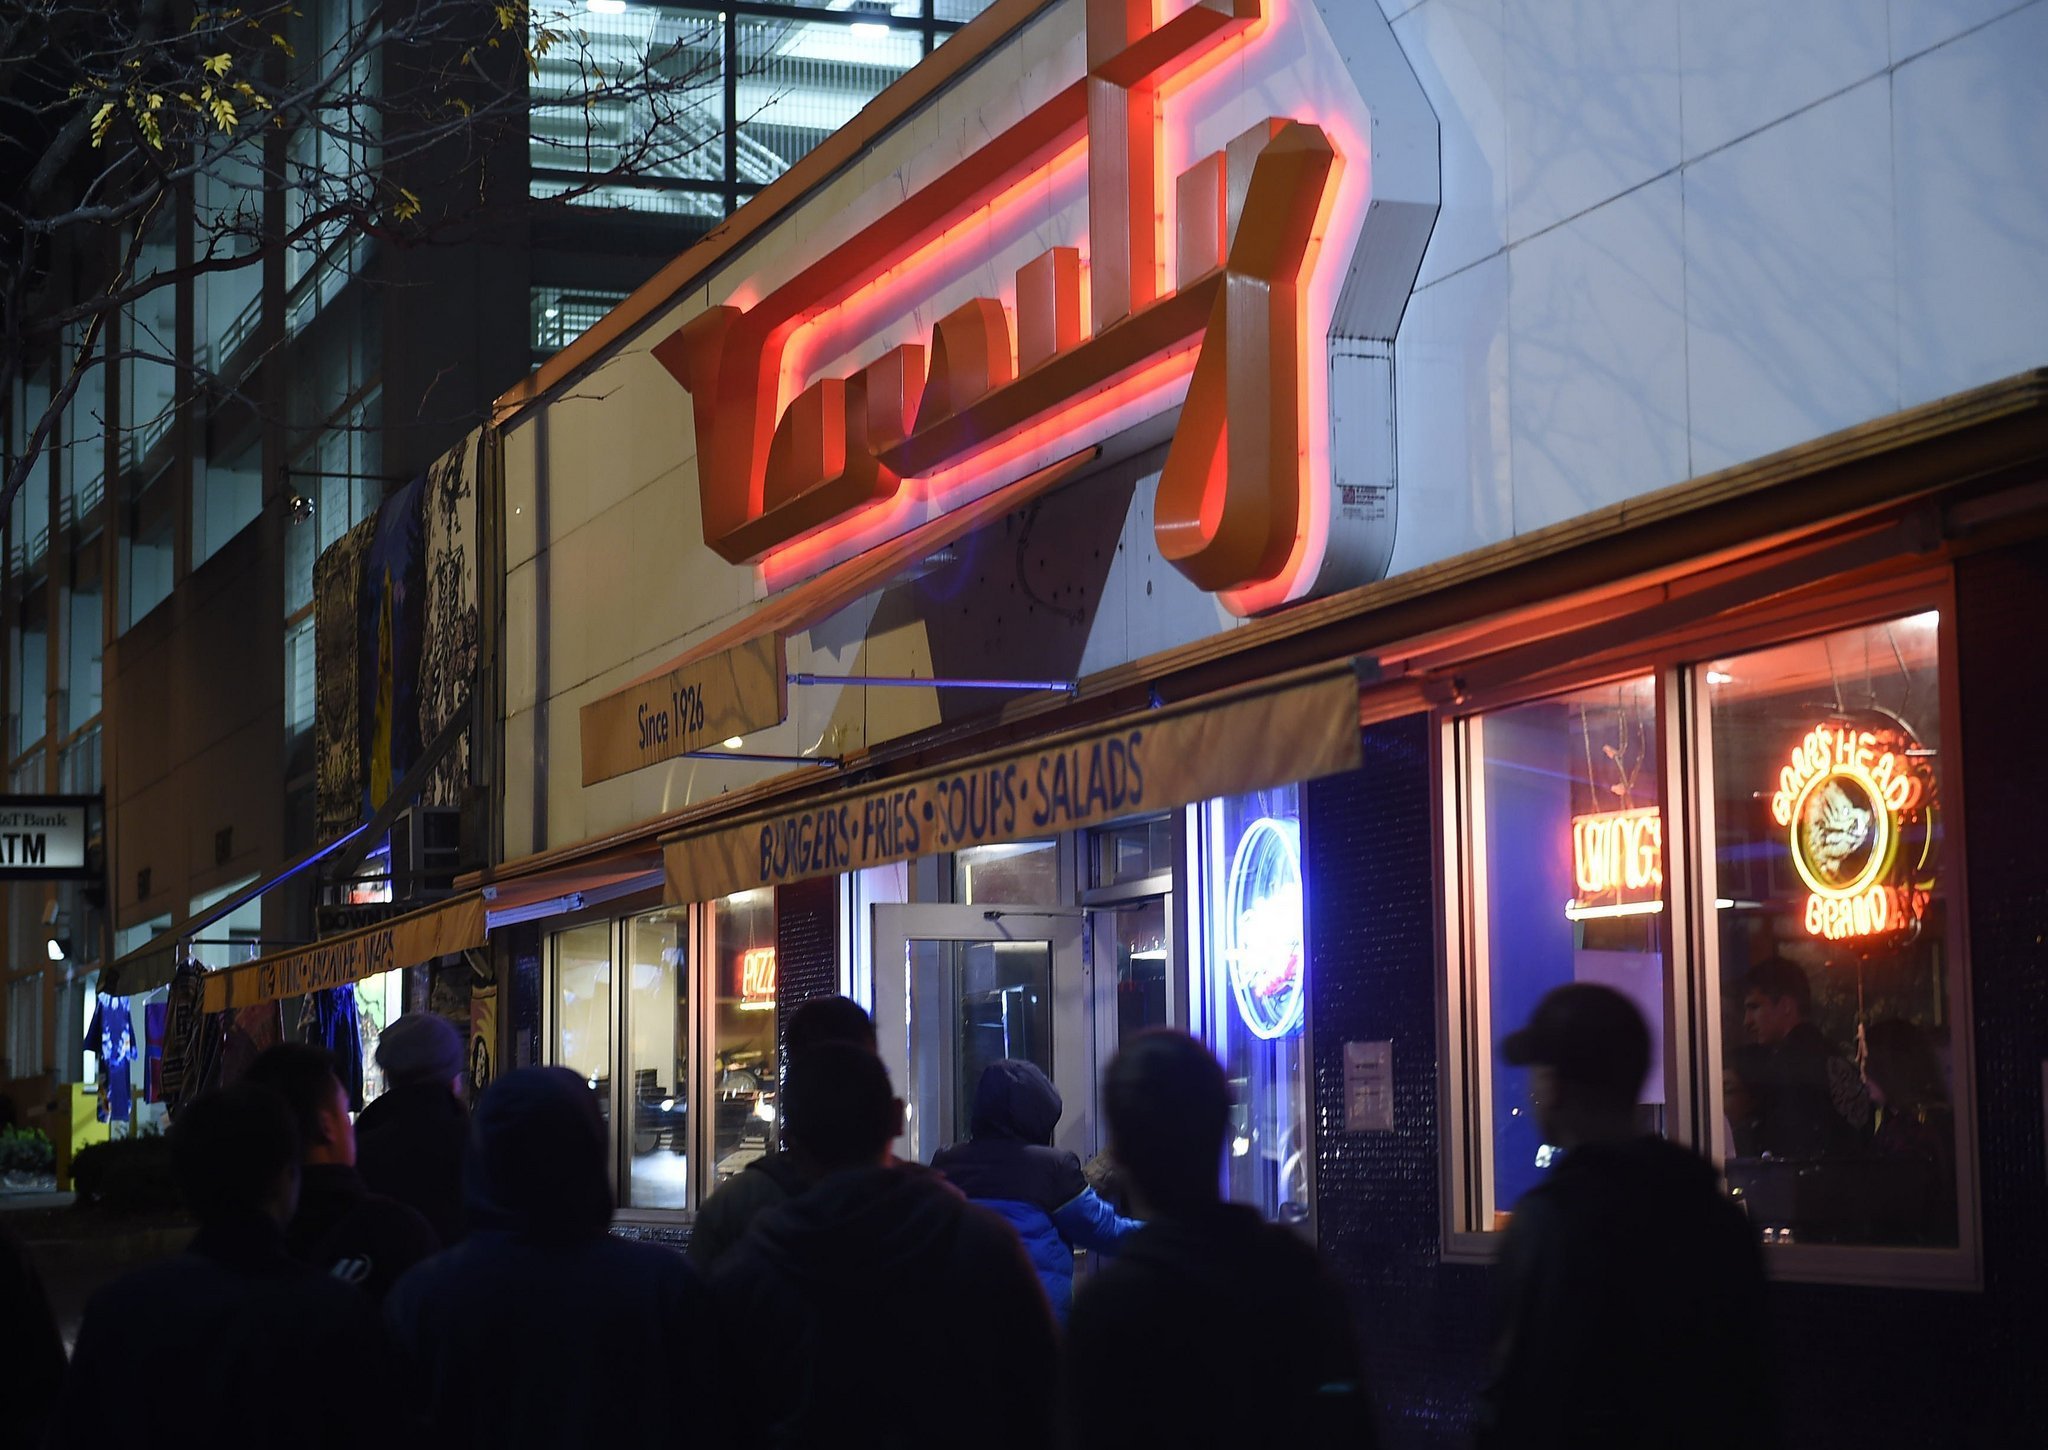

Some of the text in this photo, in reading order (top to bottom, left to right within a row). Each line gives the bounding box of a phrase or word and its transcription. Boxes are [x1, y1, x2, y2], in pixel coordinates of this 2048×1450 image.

[638, 683, 704, 750] Since 1926
[1834, 730, 1910, 812] HEAD
[23, 812, 68, 828] Bank
[759, 731, 1143, 882] BURGERS FRIES SOUPS SALADS
[1805, 884, 1886, 940] BRAND
